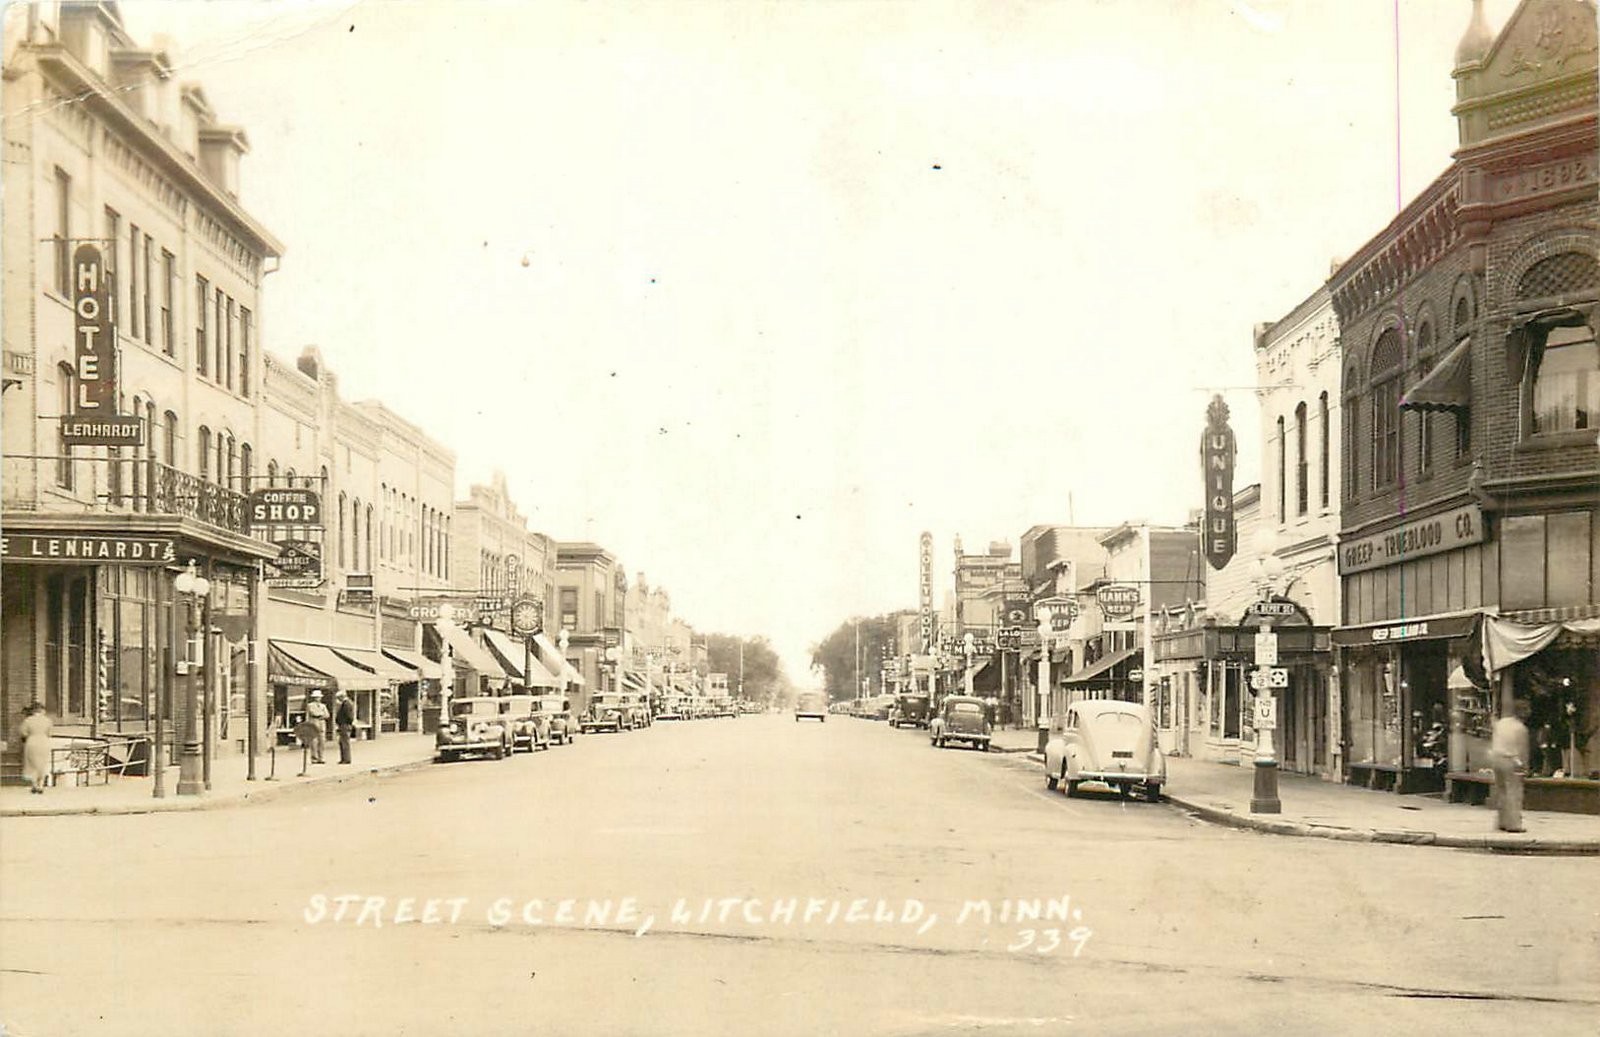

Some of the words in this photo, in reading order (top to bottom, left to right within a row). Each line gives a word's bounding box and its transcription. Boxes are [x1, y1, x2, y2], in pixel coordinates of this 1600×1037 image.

[77, 263, 100, 408] HOTEL
[63, 423, 139, 436] LENHARDT
[264, 493, 307, 503] COFFEE
[1212, 434, 1226, 553] UNIQUE
[254, 505, 316, 520] SHOP
[1384, 521, 1442, 558] TRUEBLOOD
[1455, 512, 1474, 538] CO.
[32, 539, 159, 558] LENHARDT
[410, 606, 475, 620] GROERY
